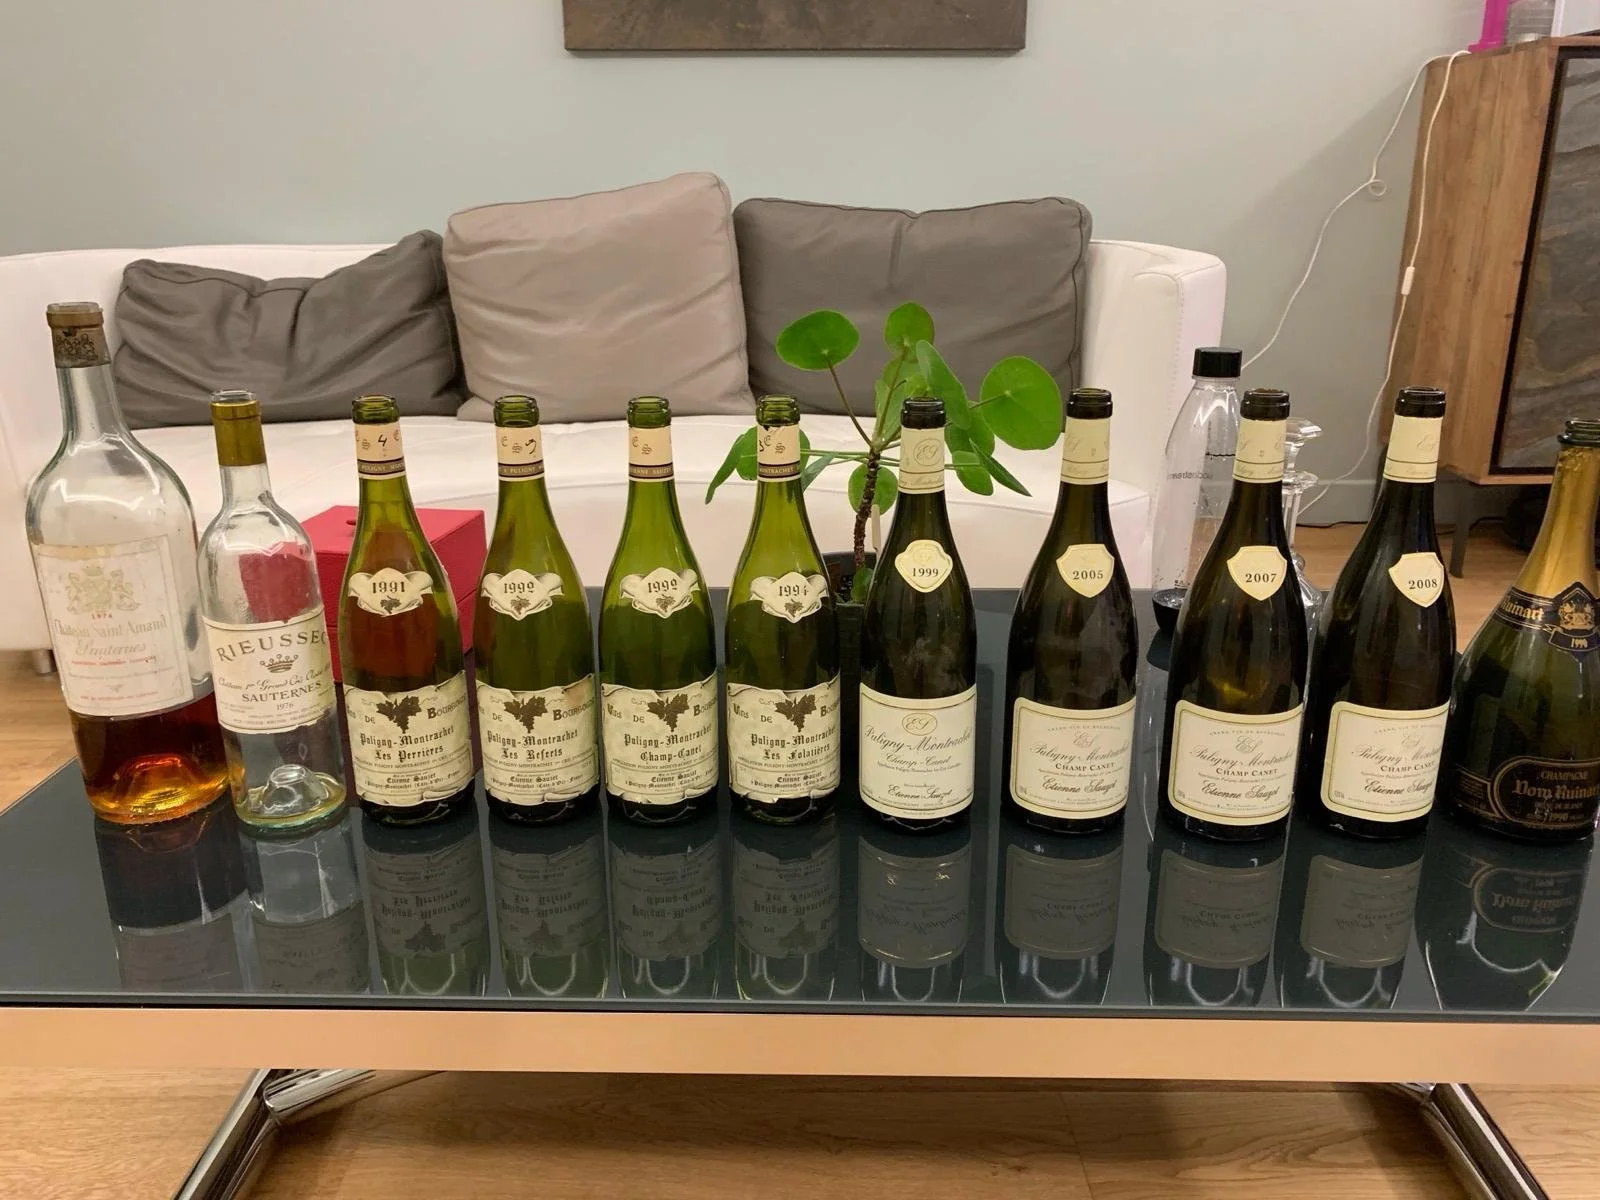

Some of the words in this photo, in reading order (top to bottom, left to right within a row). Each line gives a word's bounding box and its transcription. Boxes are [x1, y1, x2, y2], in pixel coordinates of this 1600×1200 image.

[377, 434, 388, 447] 4
[912, 568, 939, 577] 1999
[1073, 570, 1104, 580] 2005
[1245, 573, 1278, 583] 2007
[372, 581, 406, 594] 1991
[503, 581, 535, 594] 1992
[647, 578, 678, 593] 1992
[1408, 579, 1438, 590] 2008
[778, 584, 809, 597] 1994
[242, 681, 322, 702] SAUTERNES
[277, 703, 294, 711] 1976
[375, 749, 391, 760] Les
[502, 748, 518, 759] Les
[640, 744, 702, 763] Champ-Canet
[763, 749, 780, 760] Les
[1056, 762, 1087, 772] CHAMP
[1090, 762, 1114, 771] CANET
[1216, 768, 1248, 777] CHAMP
[1251, 768, 1278, 777] CANET
[1380, 765, 1411, 773] CHAMP
[1511, 779, 1552, 800] Dom
